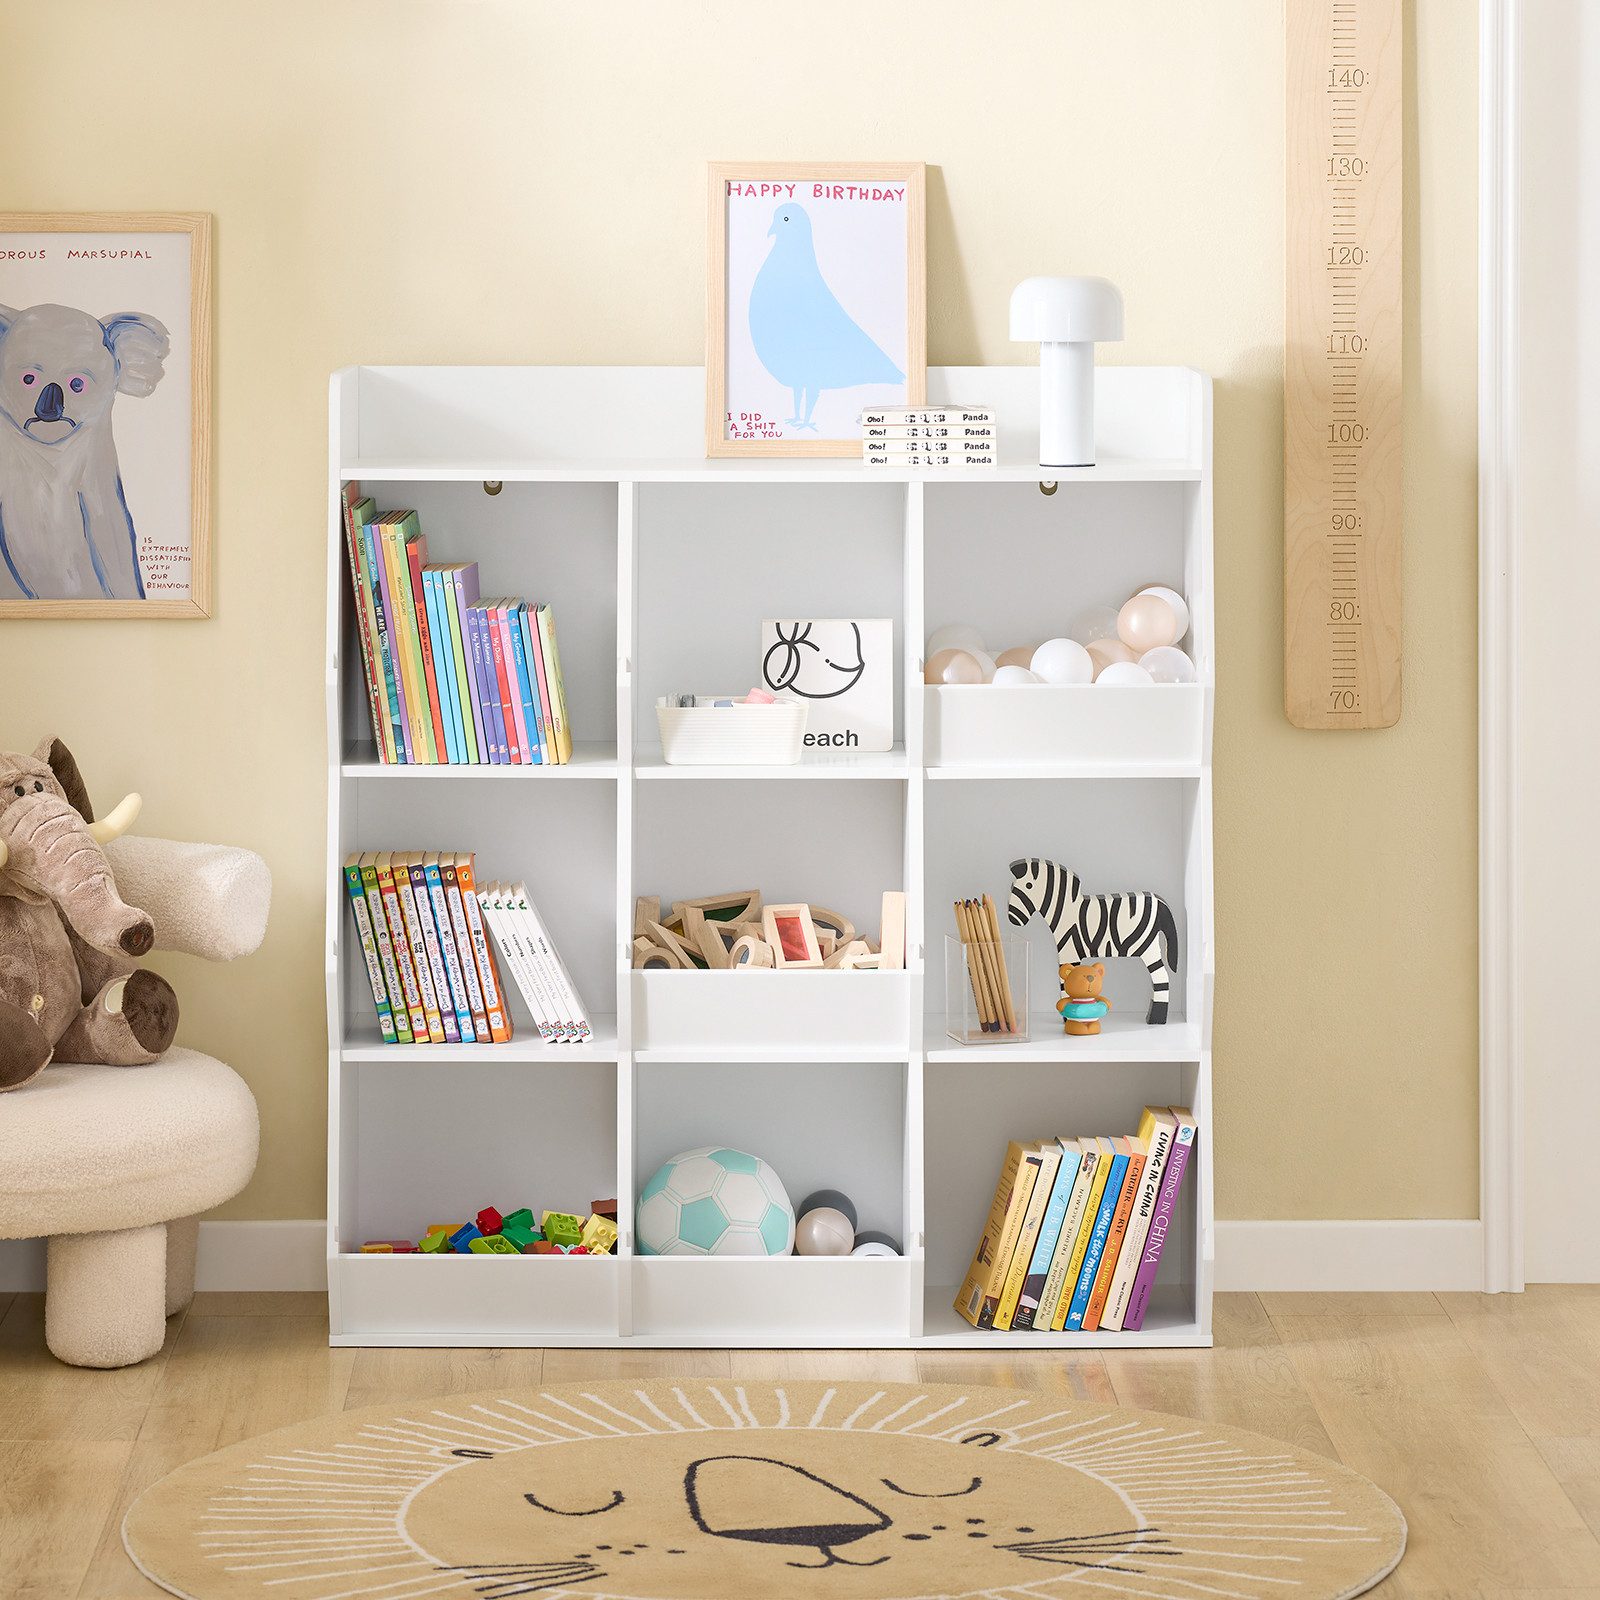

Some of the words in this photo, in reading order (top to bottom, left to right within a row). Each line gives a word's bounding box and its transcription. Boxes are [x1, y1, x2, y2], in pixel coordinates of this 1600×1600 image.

[727, 182, 796, 198] HAPPY
[814, 184, 905, 202] BIRTHDAY
[0, 249, 46, 259] OROUS
[67, 249, 152, 260] MARSUPIAL
[740, 412, 762, 421] DID
[730, 422, 738, 430] A
[747, 422, 776, 430] SHIT
[964, 428, 990, 436] Panda
[735, 431, 756, 439] FOR
[762, 431, 783, 439] YOU
[966, 456, 992, 464] Panda
[356, 536, 366, 556] Soon
[374, 605, 384, 618] WE
[376, 617, 386, 631] ARE
[470, 631, 479, 642] My
[480, 632, 489, 642] My
[491, 636, 500, 648] My
[511, 632, 520, 643] My
[493, 647, 502, 664] Daddy
[513, 642, 524, 666] Grandpa
[803, 730, 859, 746] each
[498, 937, 513, 958] Colors
[1150, 1130, 1169, 1168] LIVING
[1132, 1157, 1141, 1167] the
[1059, 1156, 1076, 1191] ESSAYS
[1146, 1168, 1159, 1183] IN
[1163, 1147, 1186, 1199] INVESTING
[1122, 1165, 1140, 1203] CATCHER
[1055, 1193, 1067, 1203] of
[1137, 1182, 1155, 1218] CHINA
[1159, 1200, 1171, 1214] IN
[1059, 1224, 1074, 1256] FREDRIK
[1069, 1186, 1085, 1225] BACKMAN
[1094, 1207, 1111, 1239] WALK
[1113, 1217, 1125, 1236] RYE
[1035, 1227, 1057, 1269] WHITE
[1088, 1236, 1103, 1258] two
[1143, 1213, 1170, 1266] CHINA
[1078, 1254, 1098, 1292] moons
[1095, 1257, 1112, 1294] SALINGER
[1061, 1284, 1073, 1301] DAHL
[1056, 1300, 1068, 1321] ROALD
[1112, 1305, 1120, 1319] Press
